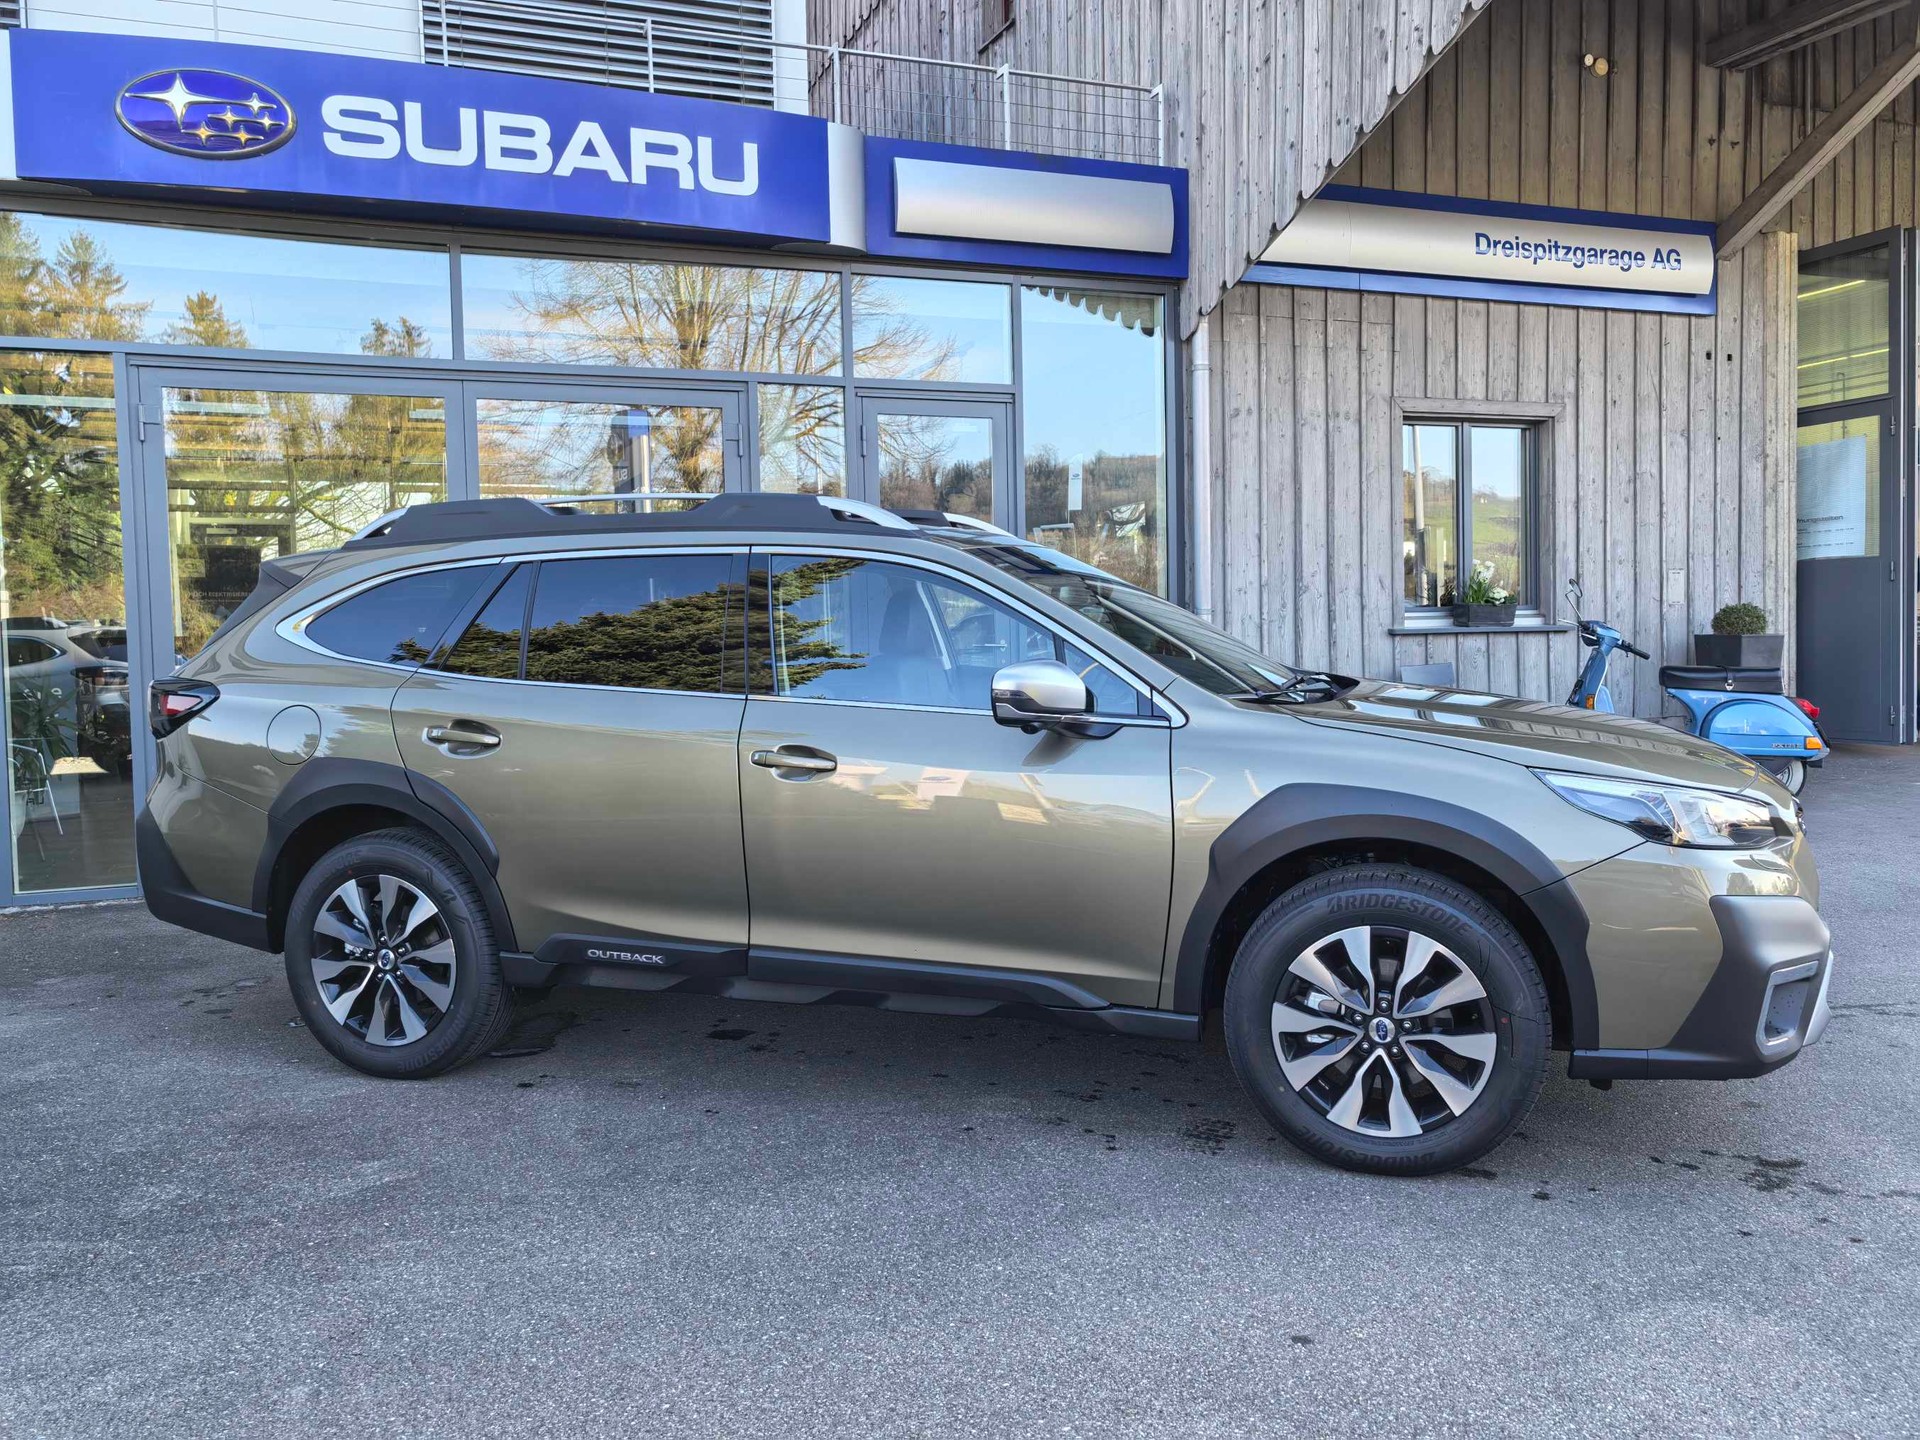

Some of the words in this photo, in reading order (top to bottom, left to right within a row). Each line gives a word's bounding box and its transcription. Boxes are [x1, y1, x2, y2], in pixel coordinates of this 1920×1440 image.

[321, 94, 759, 196] SUBARU
[1475, 232, 1646, 272] Dreispitzgarage
[1651, 247, 1682, 271] AG
[1326, 893, 1474, 937] BRIDGESTONE
[587, 949, 664, 964] OUTBACK
